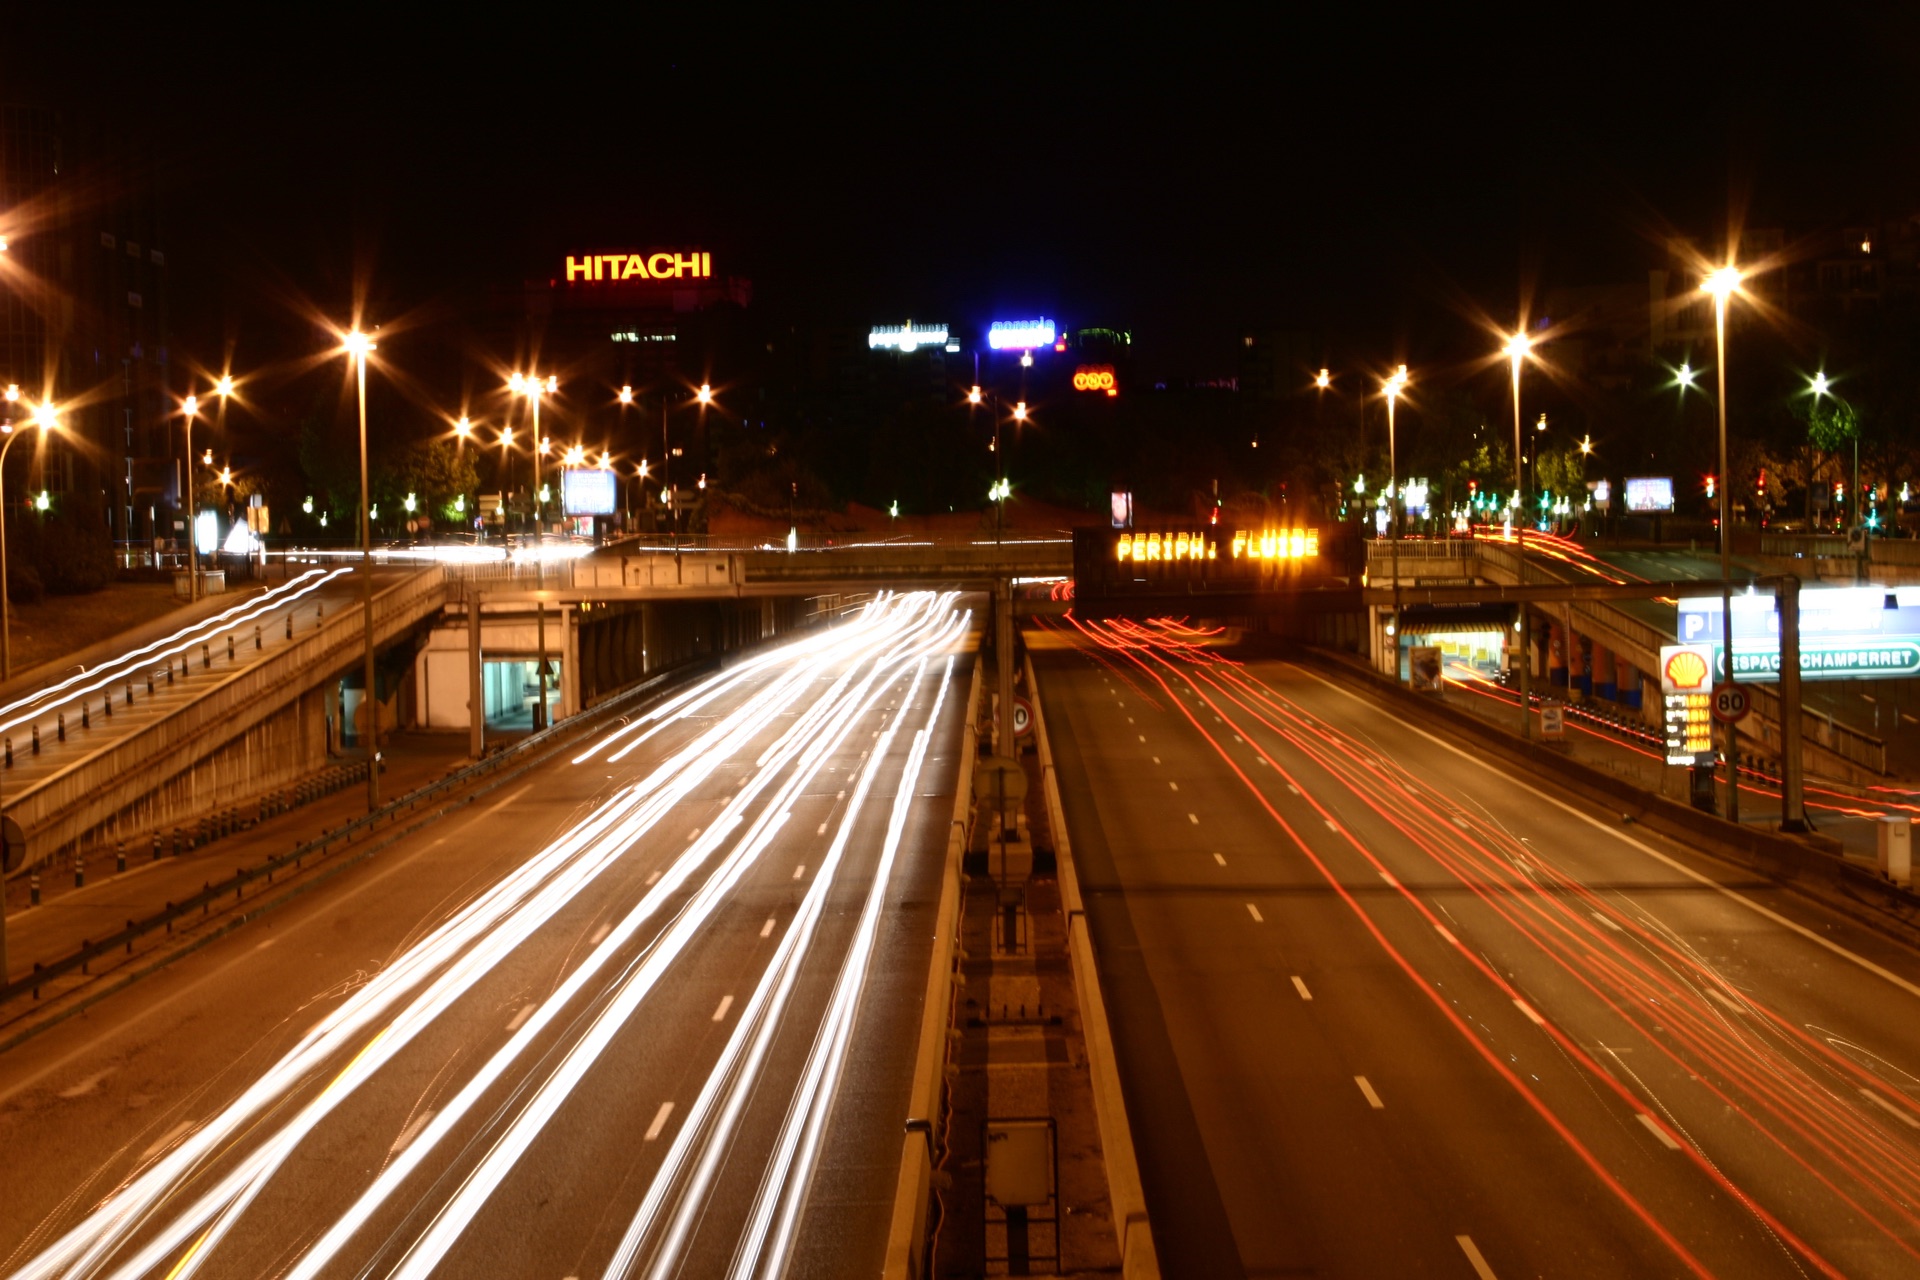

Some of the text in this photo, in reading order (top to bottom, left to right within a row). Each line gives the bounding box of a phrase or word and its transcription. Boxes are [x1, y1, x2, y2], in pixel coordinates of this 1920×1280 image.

[566, 252, 711, 281] HITACHI
[1074, 372, 1114, 390] TNT
[1232, 530, 1319, 559] FLUIDE
[1685, 614, 1704, 639] P
[1732, 650, 1912, 671] ESPAC CHAMPERRET
[1718, 693, 1744, 711] 80
